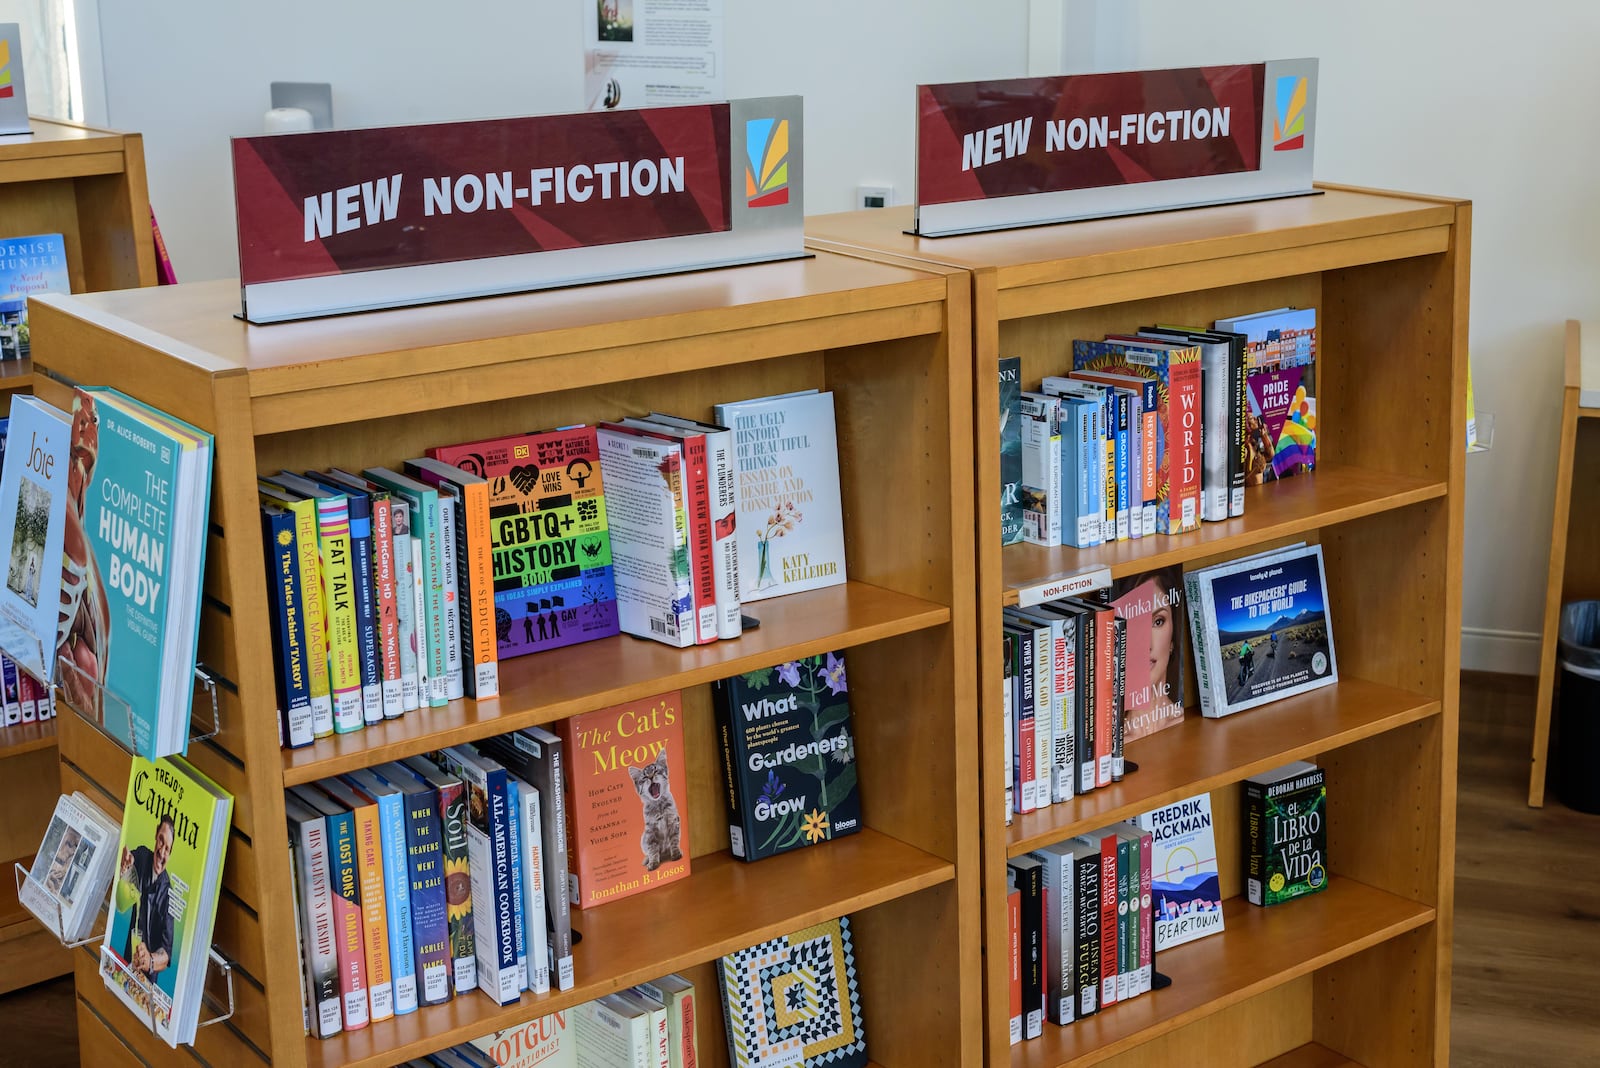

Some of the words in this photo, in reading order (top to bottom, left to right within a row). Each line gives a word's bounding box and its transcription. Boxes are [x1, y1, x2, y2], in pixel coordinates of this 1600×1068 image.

[961, 116, 1033, 172] NEW
[1045, 106, 1231, 152] NON-FICTION
[304, 174, 402, 242] NEW
[423, 156, 686, 217] NON-FICTION
[0, 242, 54, 256] DENISE
[0, 255, 58, 271] HUNTER
[1263, 380, 1289, 396] PRIDE
[1263, 394, 1289, 410] ATLAS
[1240, 364, 1248, 442] RUSSO-UKRAINIAN
[736, 415, 758, 430] THE
[760, 411, 785, 428] UGLY
[736, 425, 781, 444] HISTORY
[514, 445, 529, 459] DK
[737, 444, 750, 458] OF
[753, 435, 810, 455] BEAUTIFUL
[1120, 432, 1128, 469] CROATIA
[1181, 392, 1196, 483] WORLD
[26, 431, 54, 480] Joie
[717, 448, 725, 461] THE
[738, 454, 778, 471] THINGS
[1146, 441, 1155, 487] ENGLAND
[145, 470, 168, 505] THE
[541, 471, 561, 484] LOVE
[543, 482, 562, 494] WINS
[695, 478, 706, 495] THE
[717, 463, 729, 506] PLUNDERERS
[739, 469, 777, 486] ESSAYS
[780, 465, 793, 479] ON
[740, 484, 778, 499] DESIRE
[783, 477, 804, 494] AND
[1107, 452, 1116, 508] BELGIUM
[102, 478, 166, 536] COMPLETE
[517, 500, 540, 514] THE
[696, 500, 708, 518] NEW
[741, 488, 813, 513] CONSUMPTION
[300, 514, 314, 536] THE
[378, 506, 389, 537] Gladys
[99, 506, 164, 577] HUMAN
[444, 525, 452, 558] MIGRANT
[698, 522, 710, 551] CHINA
[281, 551, 293, 574] The
[329, 538, 346, 566] FAT
[380, 540, 391, 580] McGarey,
[429, 532, 439, 589] NAVIGATING
[492, 539, 577, 577] HISTORY
[782, 552, 810, 570] KATY
[109, 553, 161, 615] BODY
[302, 542, 322, 616] EXPERIENCE
[445, 561, 453, 584] SOULS
[522, 569, 554, 588] BOOK
[700, 554, 713, 599] PLAYBOOK
[783, 561, 838, 583] KELLEHER
[1250, 572, 1264, 581] lonely
[1269, 567, 1283, 577] planet
[284, 575, 296, 605] Tales
[331, 572, 352, 610] TALK
[384, 583, 392, 598] MD
[1043, 577, 1092, 598] NON-FICTION
[1231, 596, 1243, 610] THE
[1244, 584, 1288, 607] BIKEPACKERS'
[1288, 579, 1308, 595] GUIDE
[561, 609, 577, 622] GAY
[1116, 600, 1151, 620] Minka
[1153, 587, 1182, 608] Kelly
[1248, 606, 1257, 619] TO
[1259, 601, 1271, 616] THE
[1271, 596, 1294, 613] WORLD
[287, 607, 300, 648] Behind
[309, 622, 326, 678] MACHINE
[1023, 640, 1033, 665] POWER
[1039, 633, 1050, 682] LINCOLN'S
[1055, 638, 1066, 670] HONEST
[1104, 621, 1115, 679] Homegrown
[290, 647, 304, 689] TAROT
[1024, 667, 1033, 699] PLAYERS
[1040, 686, 1049, 706] GOD
[1055, 674, 1065, 693] MAN
[1129, 687, 1149, 708] Tell
[1151, 681, 1171, 698] Me
[742, 693, 797, 722] What
[580, 728, 611, 749] The
[617, 701, 675, 738] Cat's
[592, 739, 668, 775] Meow
[747, 736, 779, 749] plantspeople
[749, 734, 848, 771] Gardeners
[1055, 737, 1066, 764] RISEN
[1065, 734, 1075, 764] JAMES
[155, 768, 184, 800] TREJO'S
[1268, 781, 1295, 797] DEBORAH
[1295, 773, 1323, 789] HARKNESS
[134, 770, 199, 849] Cantina
[392, 801, 402, 817] the
[412, 808, 431, 820] WHEN
[754, 795, 806, 822] Grow
[1152, 800, 1202, 827] FREDRIK
[309, 828, 323, 849] HIS
[340, 821, 348, 834] THE
[365, 820, 374, 845] TAKING
[417, 826, 429, 836] THE
[446, 802, 470, 850] Soil
[835, 818, 857, 832] bloom
[1273, 811, 1320, 845] LIBRO
[339, 838, 352, 864] LOST
[393, 819, 407, 871] wellness
[409, 841, 439, 856] HEAVENS
[492, 793, 510, 889] ALL-AMERICAN
[509, 819, 519, 864] UNOFFICIAL
[367, 848, 375, 866] CARE
[417, 860, 435, 872] WENT
[310, 851, 328, 909] MAJESTY'S
[342, 868, 355, 897] SONS
[395, 875, 409, 901] trap
[413, 880, 423, 890] ON
[425, 878, 441, 888] SALE
[512, 867, 522, 912] DOLLYWOOD
[590, 879, 639, 901] Jonathan
[642, 874, 653, 885] B.
[656, 864, 685, 880] Losos
[1106, 855, 1117, 904] ARTURO
[1085, 862, 1100, 935] ARTURO
[316, 912, 332, 955] AIRSHIP
[345, 913, 359, 952] OMAHA
[400, 906, 409, 932] Christy
[499, 892, 515, 963] COOKBOOK
[514, 914, 524, 951] COOKBOOK
[1158, 913, 1220, 944] BEARTOWN
[402, 935, 411, 968] Harrison
[420, 941, 445, 954] ASHLEE
[678, 1003, 699, 1057] Shakespeare
